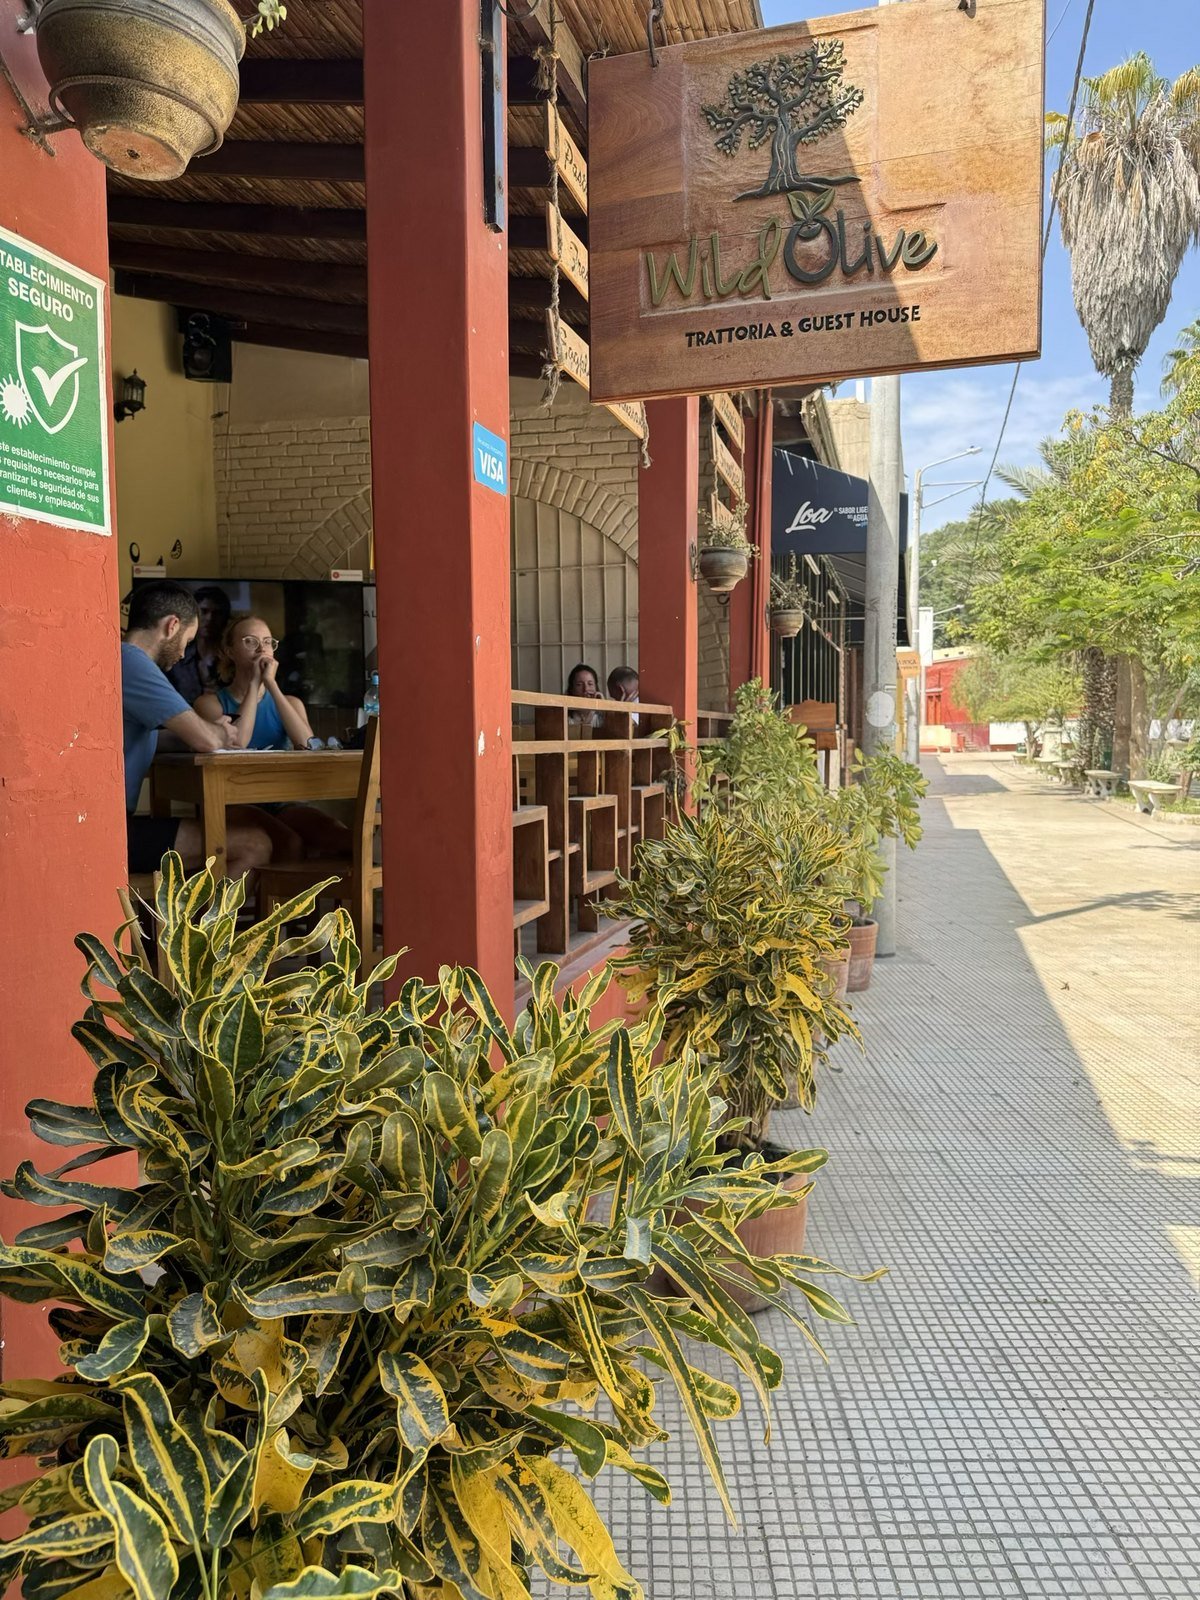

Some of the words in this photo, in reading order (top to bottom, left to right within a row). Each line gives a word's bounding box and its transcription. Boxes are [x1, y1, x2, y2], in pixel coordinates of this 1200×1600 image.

[8, 277, 74, 322] SEGURO
[685, 323, 777, 348] TRATTORIA
[780, 321, 794, 338] &
[798, 312, 855, 333] GUEST
[859, 305, 921, 327] HOUSE
[3, 456, 43, 475] requisitos
[43, 468, 83, 487] necesarios
[83, 480, 99, 491] para
[11, 445, 70, 471] establecimiento
[71, 465, 96, 478] cumple
[477, 447, 504, 485] VISA
[6, 484, 37, 500] clientes
[38, 493, 43, 503] y
[45, 495, 87, 512] empleados.
[30, 475, 38, 487] la
[39, 481, 76, 497] seguridad
[76, 490, 86, 500] de
[86, 493, 100, 503] sus
[785, 501, 834, 534] Loa
